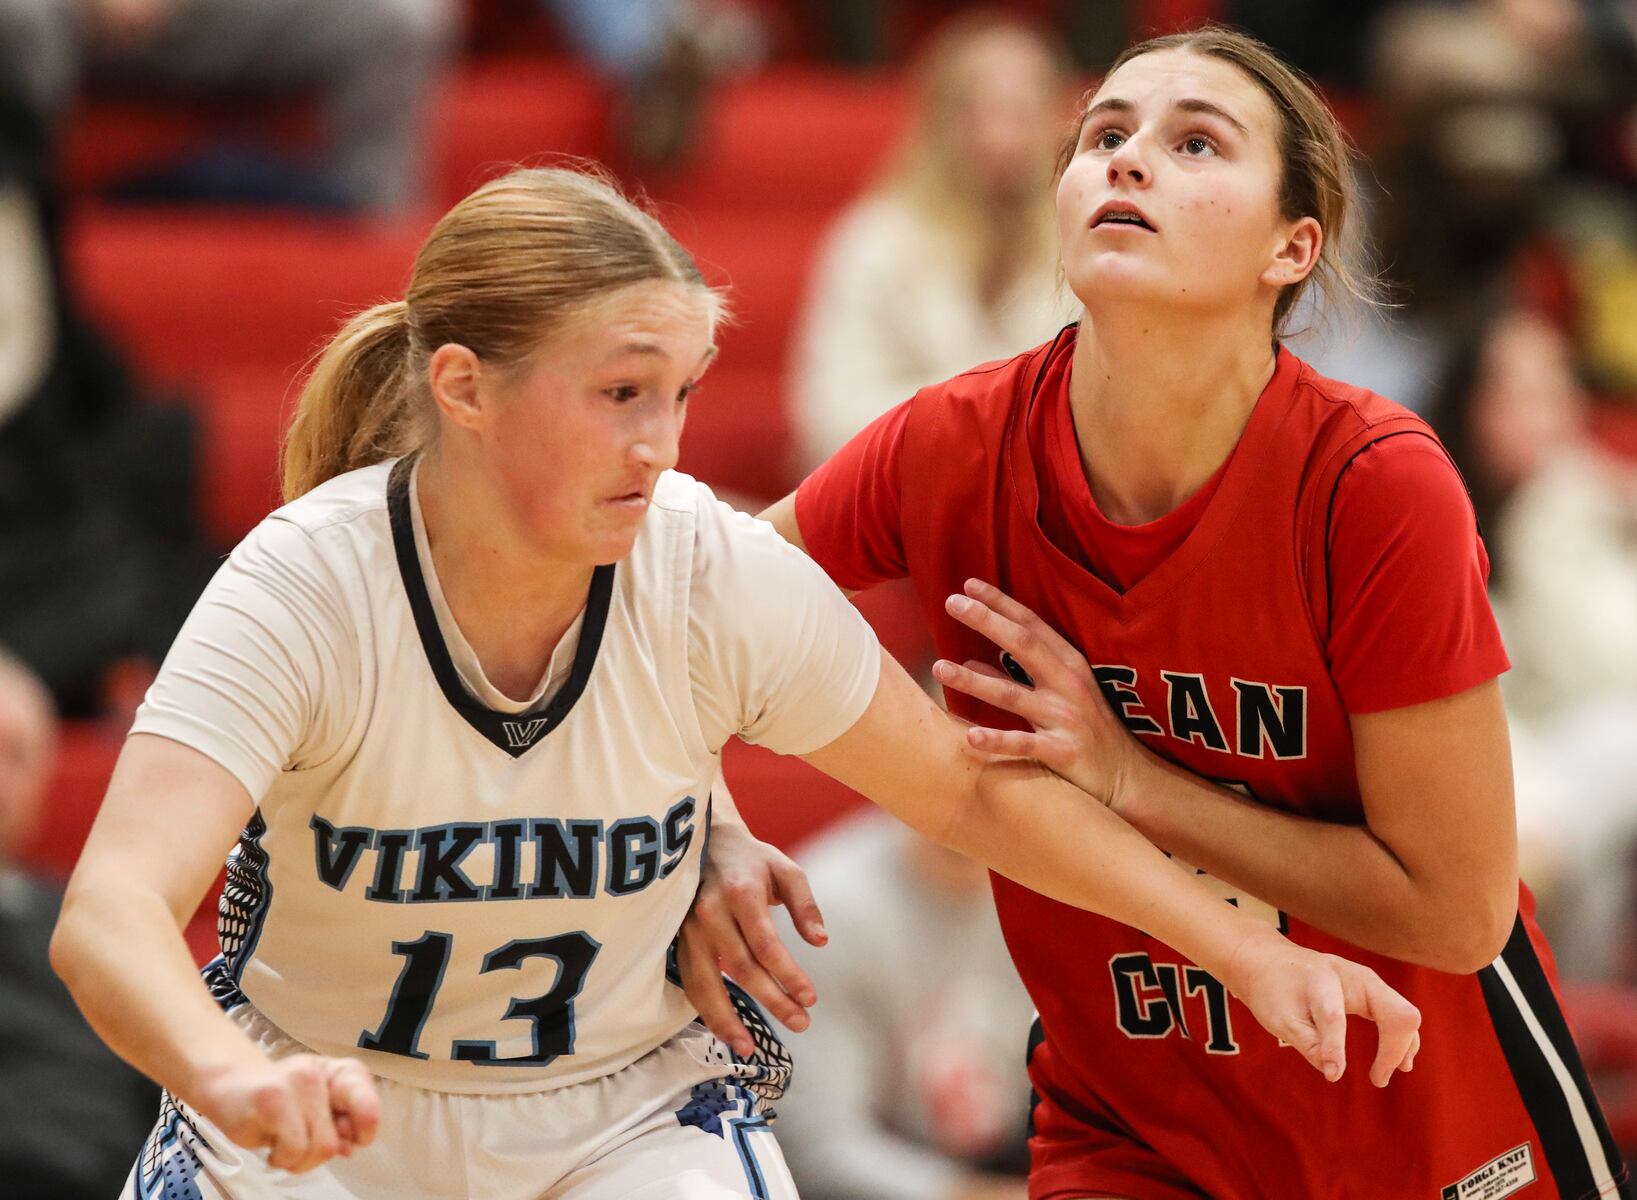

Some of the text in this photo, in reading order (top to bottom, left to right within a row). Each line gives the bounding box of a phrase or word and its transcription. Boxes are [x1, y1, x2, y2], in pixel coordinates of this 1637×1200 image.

[1001, 651, 1307, 760] EAN
[310, 796, 696, 904] VIKINGS
[357, 930, 602, 1067] 13
[1108, 952, 1289, 1055] CIT
[1462, 1166, 1496, 1192] FORGE
[1498, 1150, 1526, 1170] KNIT
